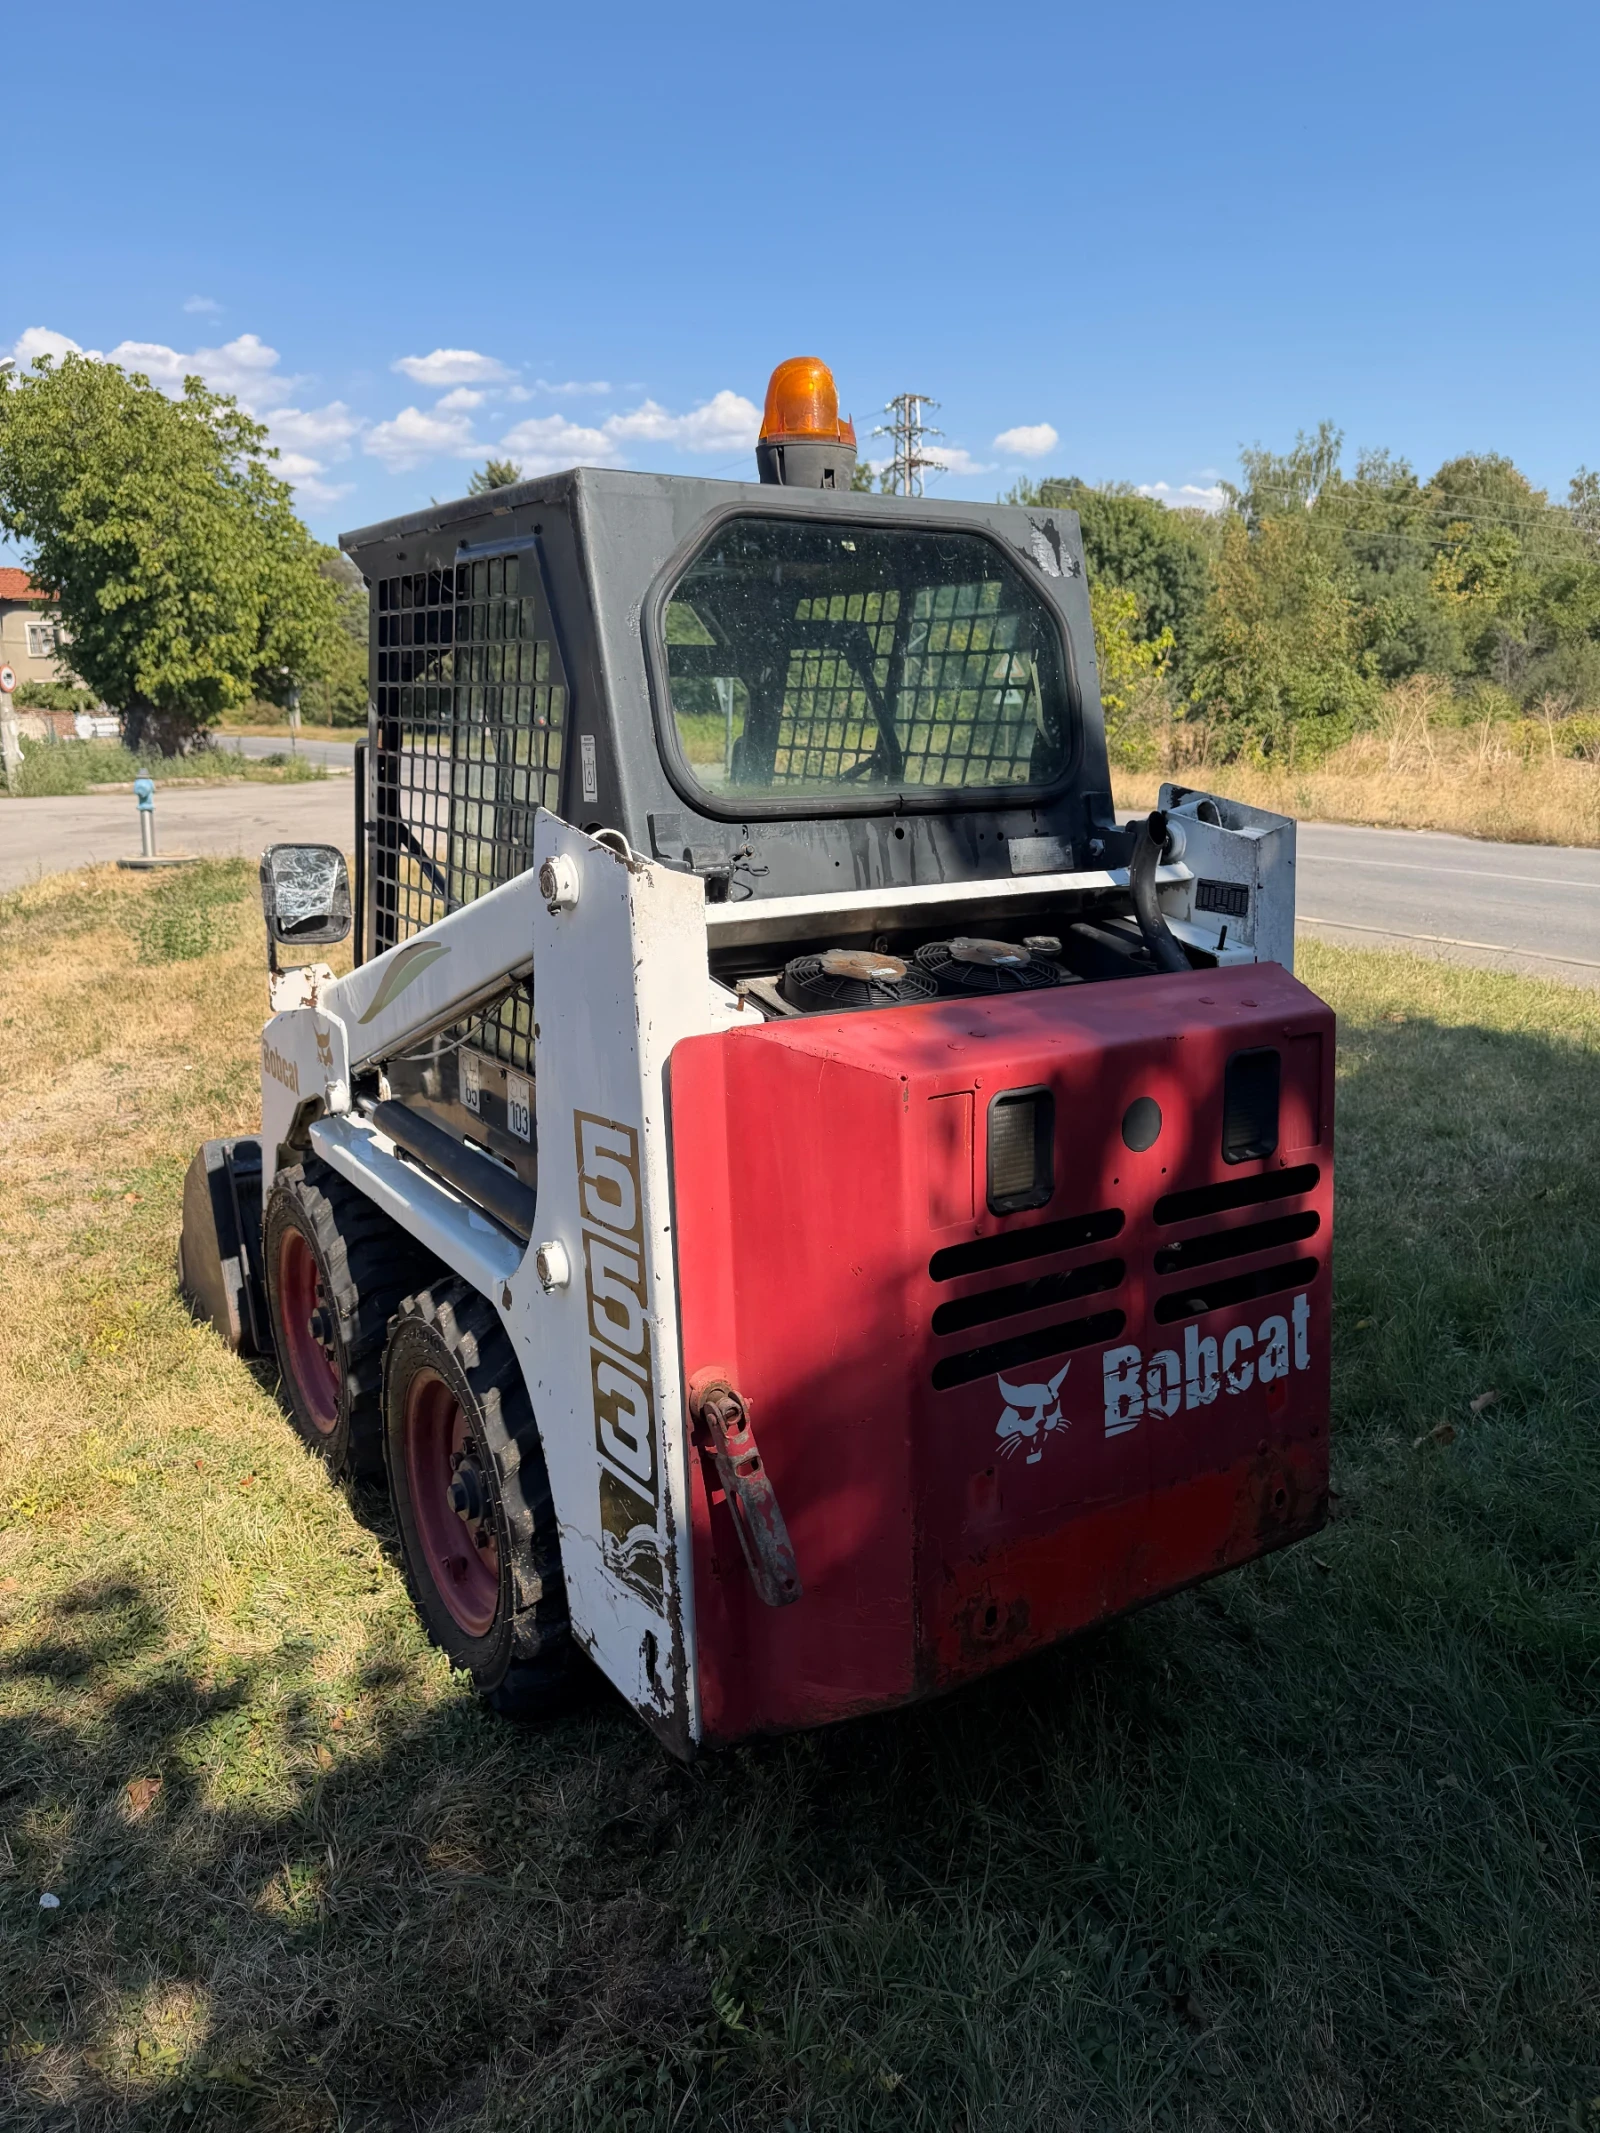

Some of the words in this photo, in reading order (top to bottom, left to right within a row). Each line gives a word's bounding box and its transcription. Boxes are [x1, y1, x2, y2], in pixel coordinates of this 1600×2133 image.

[509, 1100, 529, 1136] 103
[575, 1112, 656, 1486] 553
[1102, 1292, 1311, 1439] Bobcat
